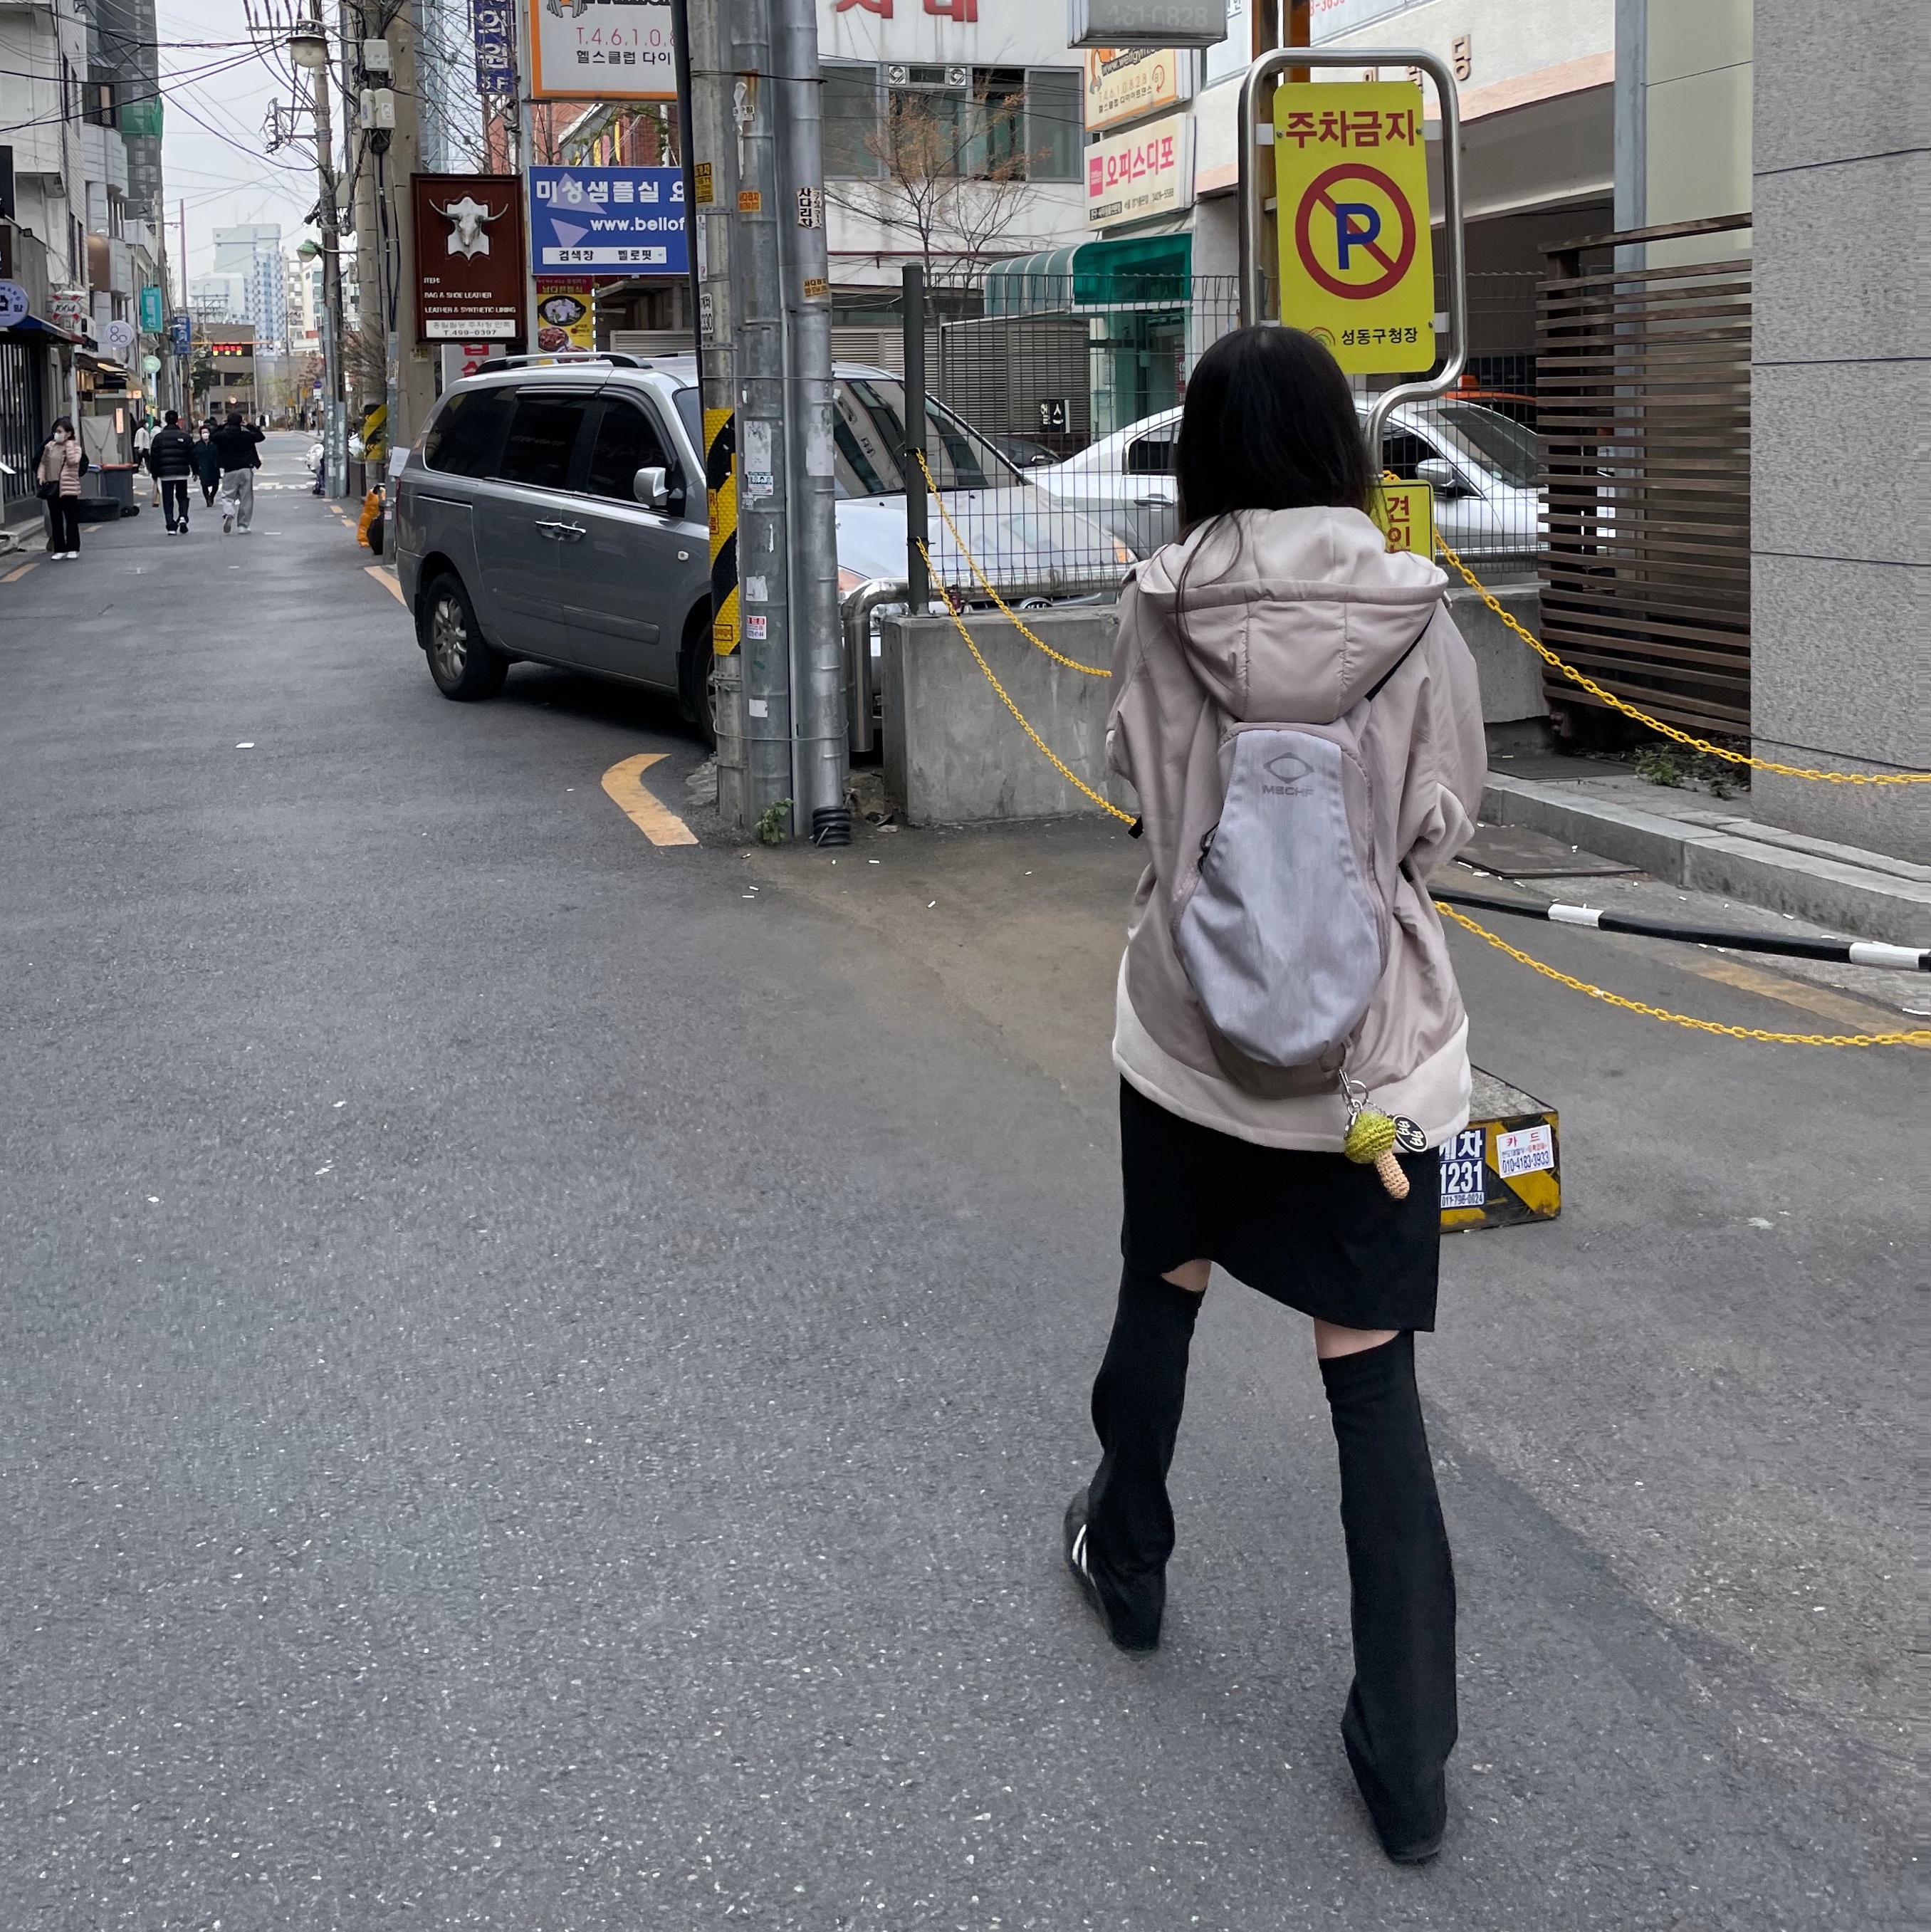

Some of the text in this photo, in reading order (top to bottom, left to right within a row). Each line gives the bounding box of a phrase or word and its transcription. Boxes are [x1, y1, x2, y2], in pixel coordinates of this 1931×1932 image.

[577, 50, 636, 65] 헬스클럽
[1286, 110, 1415, 148] 주차금지
[1106, 136, 1174, 187] 오피스디포
[536, 181, 659, 204] 미성샘플실
[799, 187, 813, 228] 사다리차
[559, 250, 652, 261] 검색창 벨로핏
[1341, 328, 1418, 345] 성동구청장
